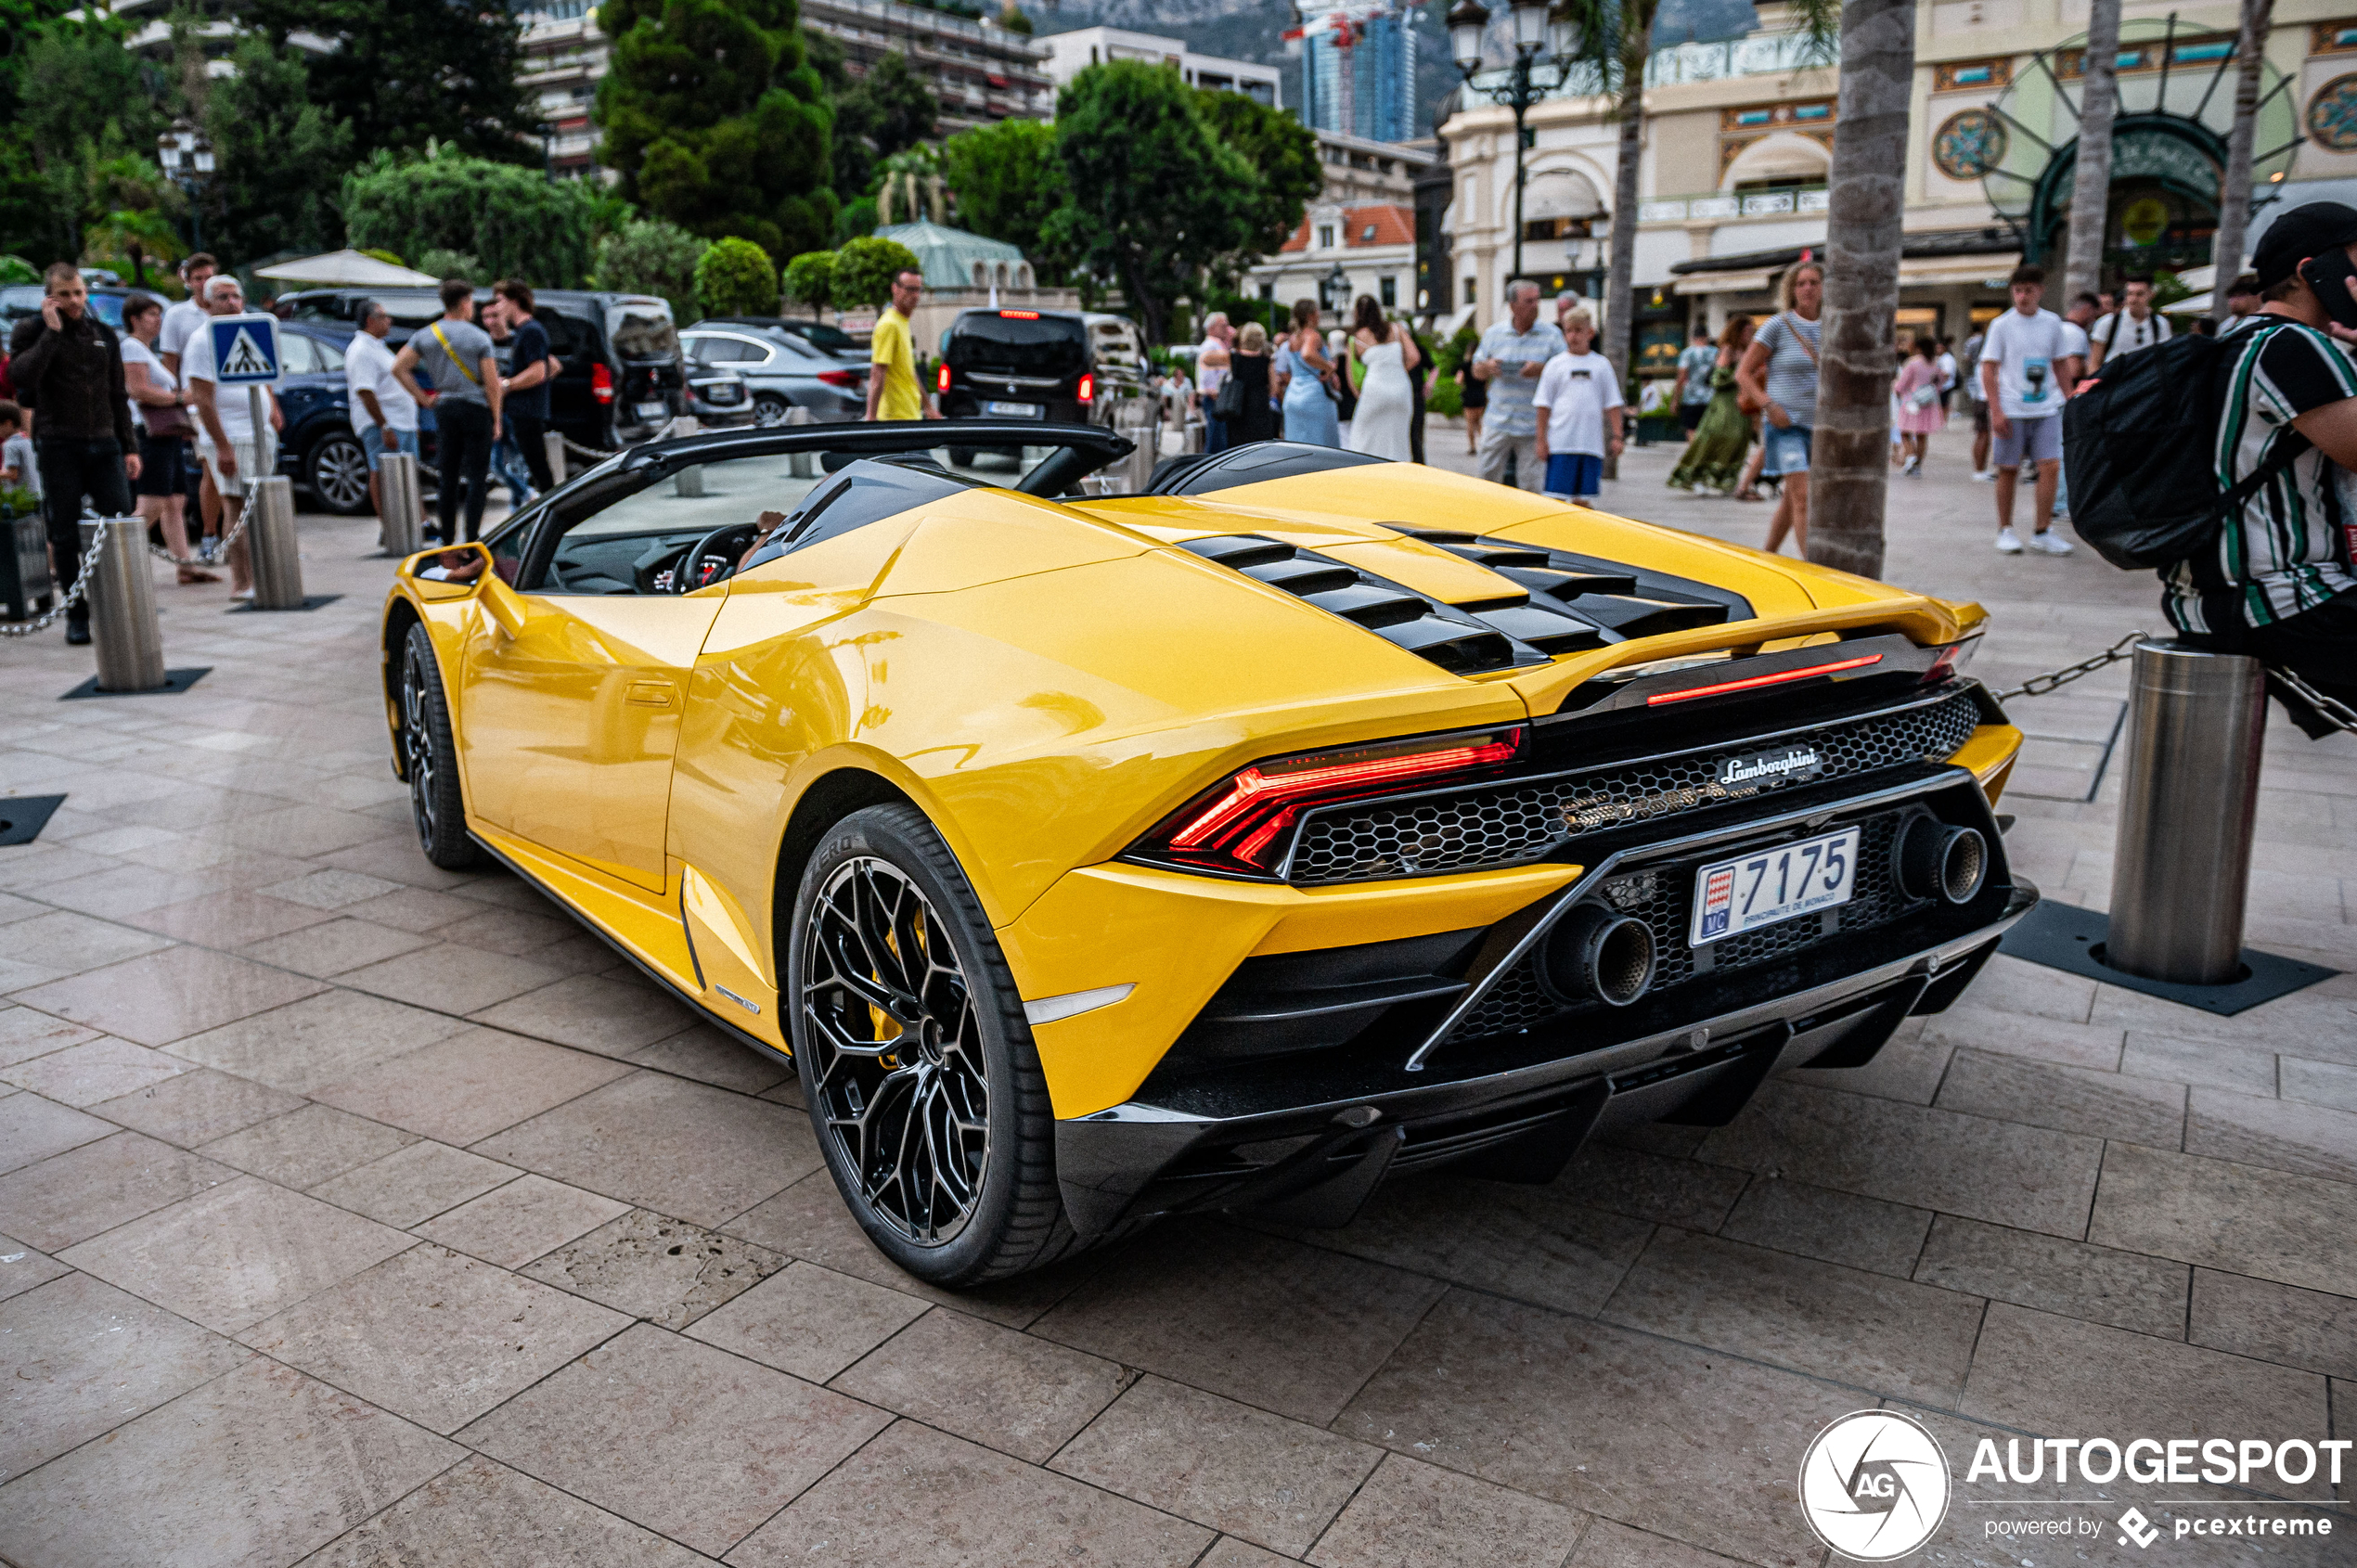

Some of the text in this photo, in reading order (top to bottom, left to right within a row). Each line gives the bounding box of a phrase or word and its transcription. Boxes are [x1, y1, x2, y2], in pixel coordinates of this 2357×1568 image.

[1720, 747, 1818, 784] Lamborghini
[1742, 838, 1847, 915] 7175
[1707, 912, 1726, 932] MC
